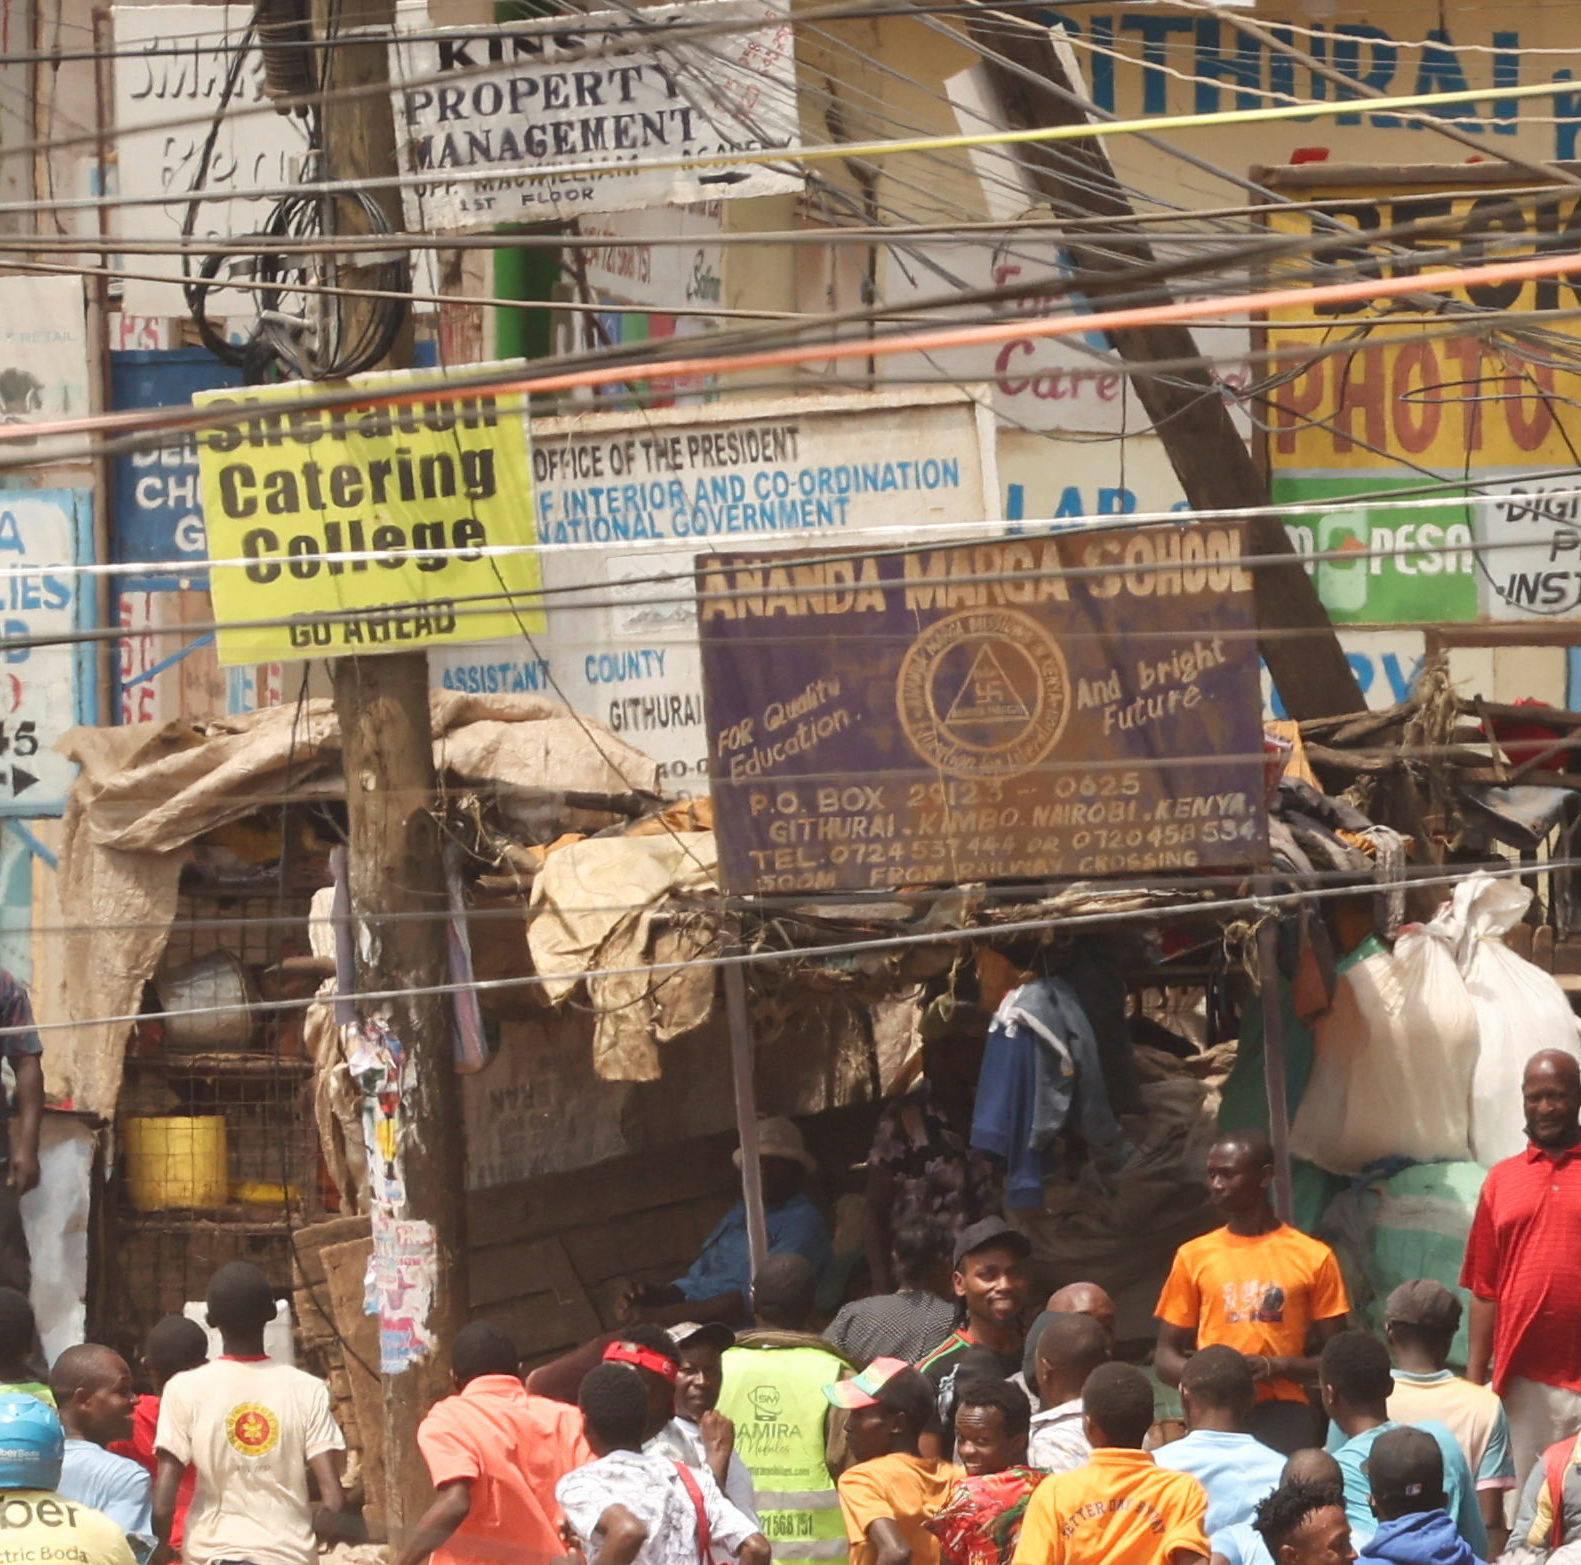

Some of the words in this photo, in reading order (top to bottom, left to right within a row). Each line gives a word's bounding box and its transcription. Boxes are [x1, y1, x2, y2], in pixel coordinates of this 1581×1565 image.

[405, 62, 681, 127] PROPERTY
[406, 107, 698, 172] MANAGEMENT
[521, 187, 595, 206] FLOOR
[20, 330, 76, 344] RETAIL
[995, 339, 1120, 402] Care
[1276, 337, 1554, 455] PHOTO
[534, 440, 602, 481] OFFICE
[610, 440, 637, 476] OF
[641, 437, 684, 472] THE
[687, 427, 800, 469] PRESIDENT
[219, 446, 497, 519] Catering
[564, 480, 684, 518] INTERIOR
[696, 476, 745, 508] AND
[755, 458, 959, 502] CO-ORDINATION
[672, 497, 851, 538] GOVERNMENT
[241, 517, 487, 584] College
[702, 553, 887, 621] ANANDA
[903, 539, 1069, 611] MARGA
[1083, 529, 1254, 600] SCHOOL
[1371, 522, 1475, 576] PESA
[289, 612, 331, 649] GO
[343, 599, 457, 645] AHEAD
[442, 657, 550, 693] ASSISTANT
[585, 649, 667, 684] COUNTY
[1076, 672, 1121, 711] And
[1139, 636, 1226, 687] bright
[610, 694, 703, 732] GITHURAI
[718, 718, 755, 757] FOR
[763, 680, 841, 729] Quality
[817, 786, 885, 813] BOX
[871, 865, 945, 887] FROM
[1079, 849, 1200, 874] CROSSING
[736, 1422, 803, 1440] AMIRA
[40, 1545, 90, 1565] Boda
